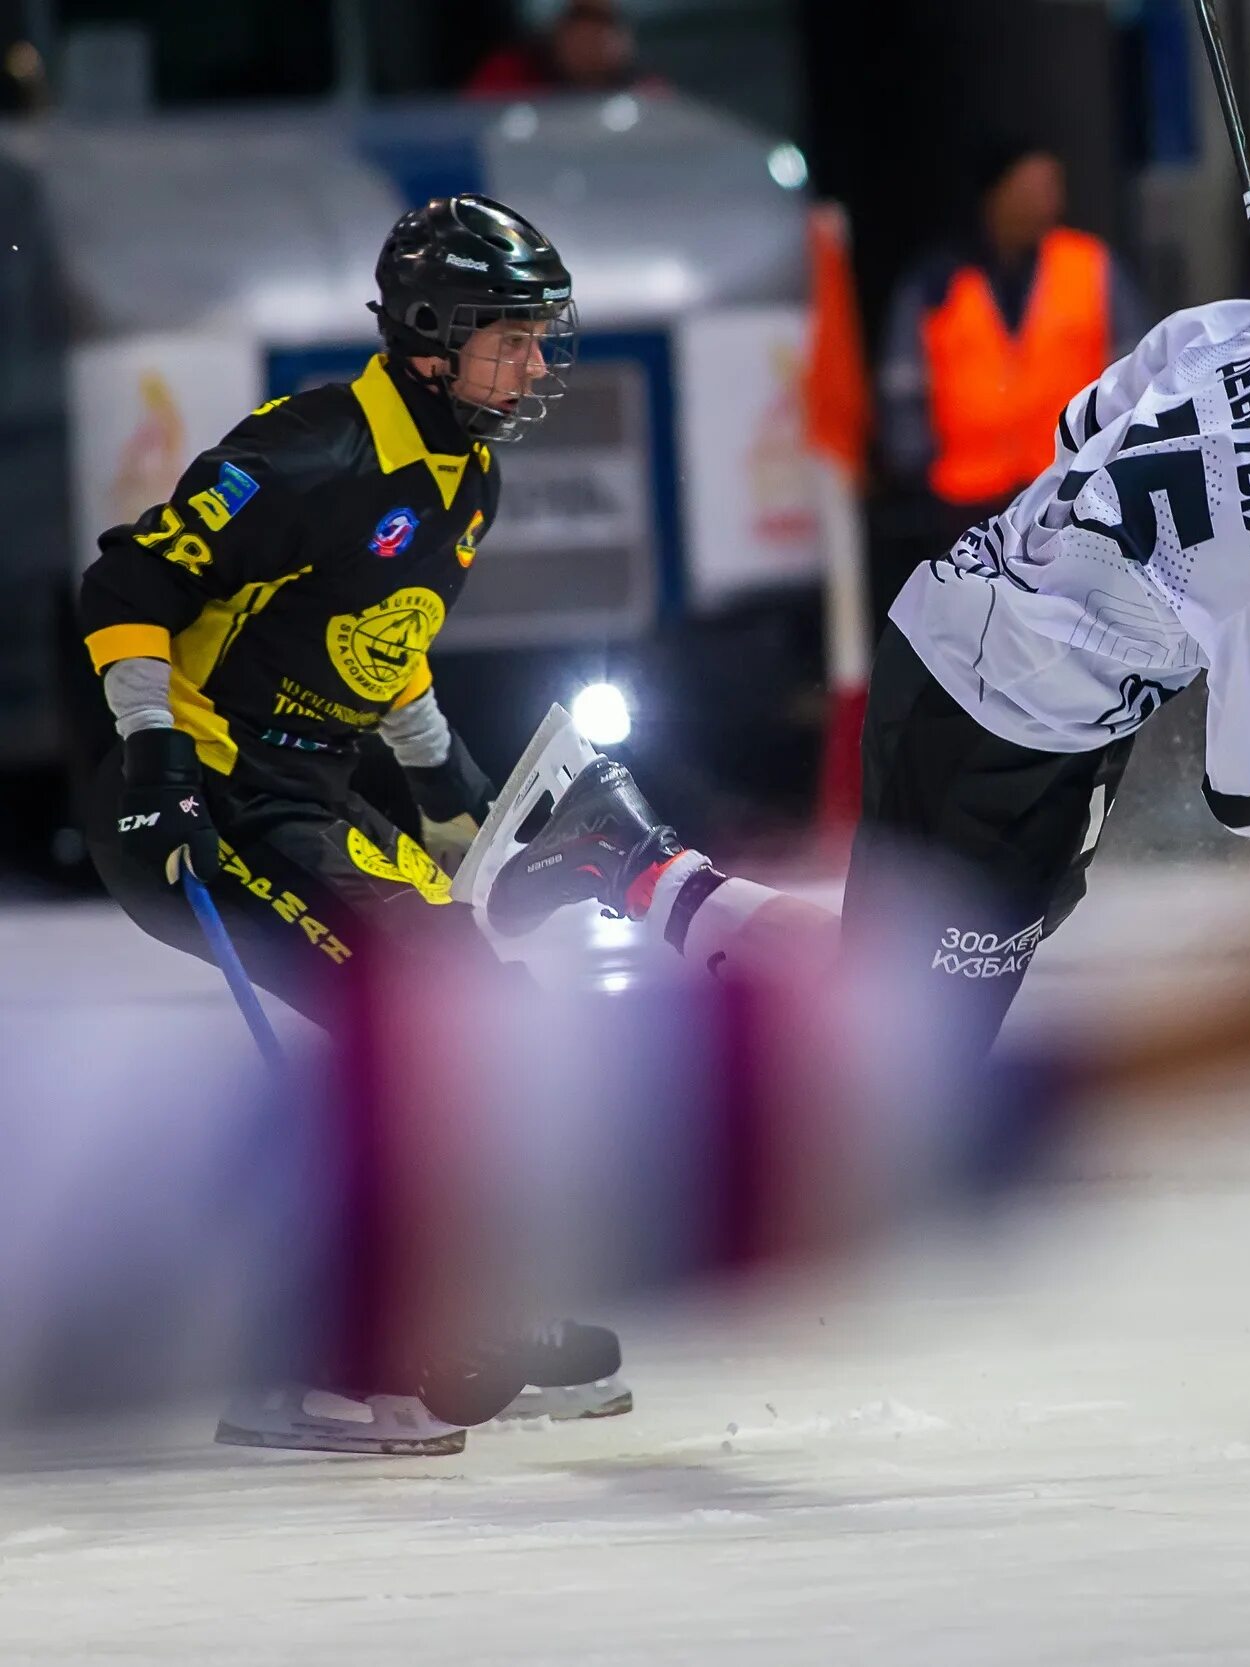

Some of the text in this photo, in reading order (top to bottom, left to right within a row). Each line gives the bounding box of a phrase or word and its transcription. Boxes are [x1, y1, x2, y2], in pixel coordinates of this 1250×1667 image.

[337, 623, 351, 655] SEA
[118, 811, 161, 832] CM
[941, 927, 999, 954] 300
